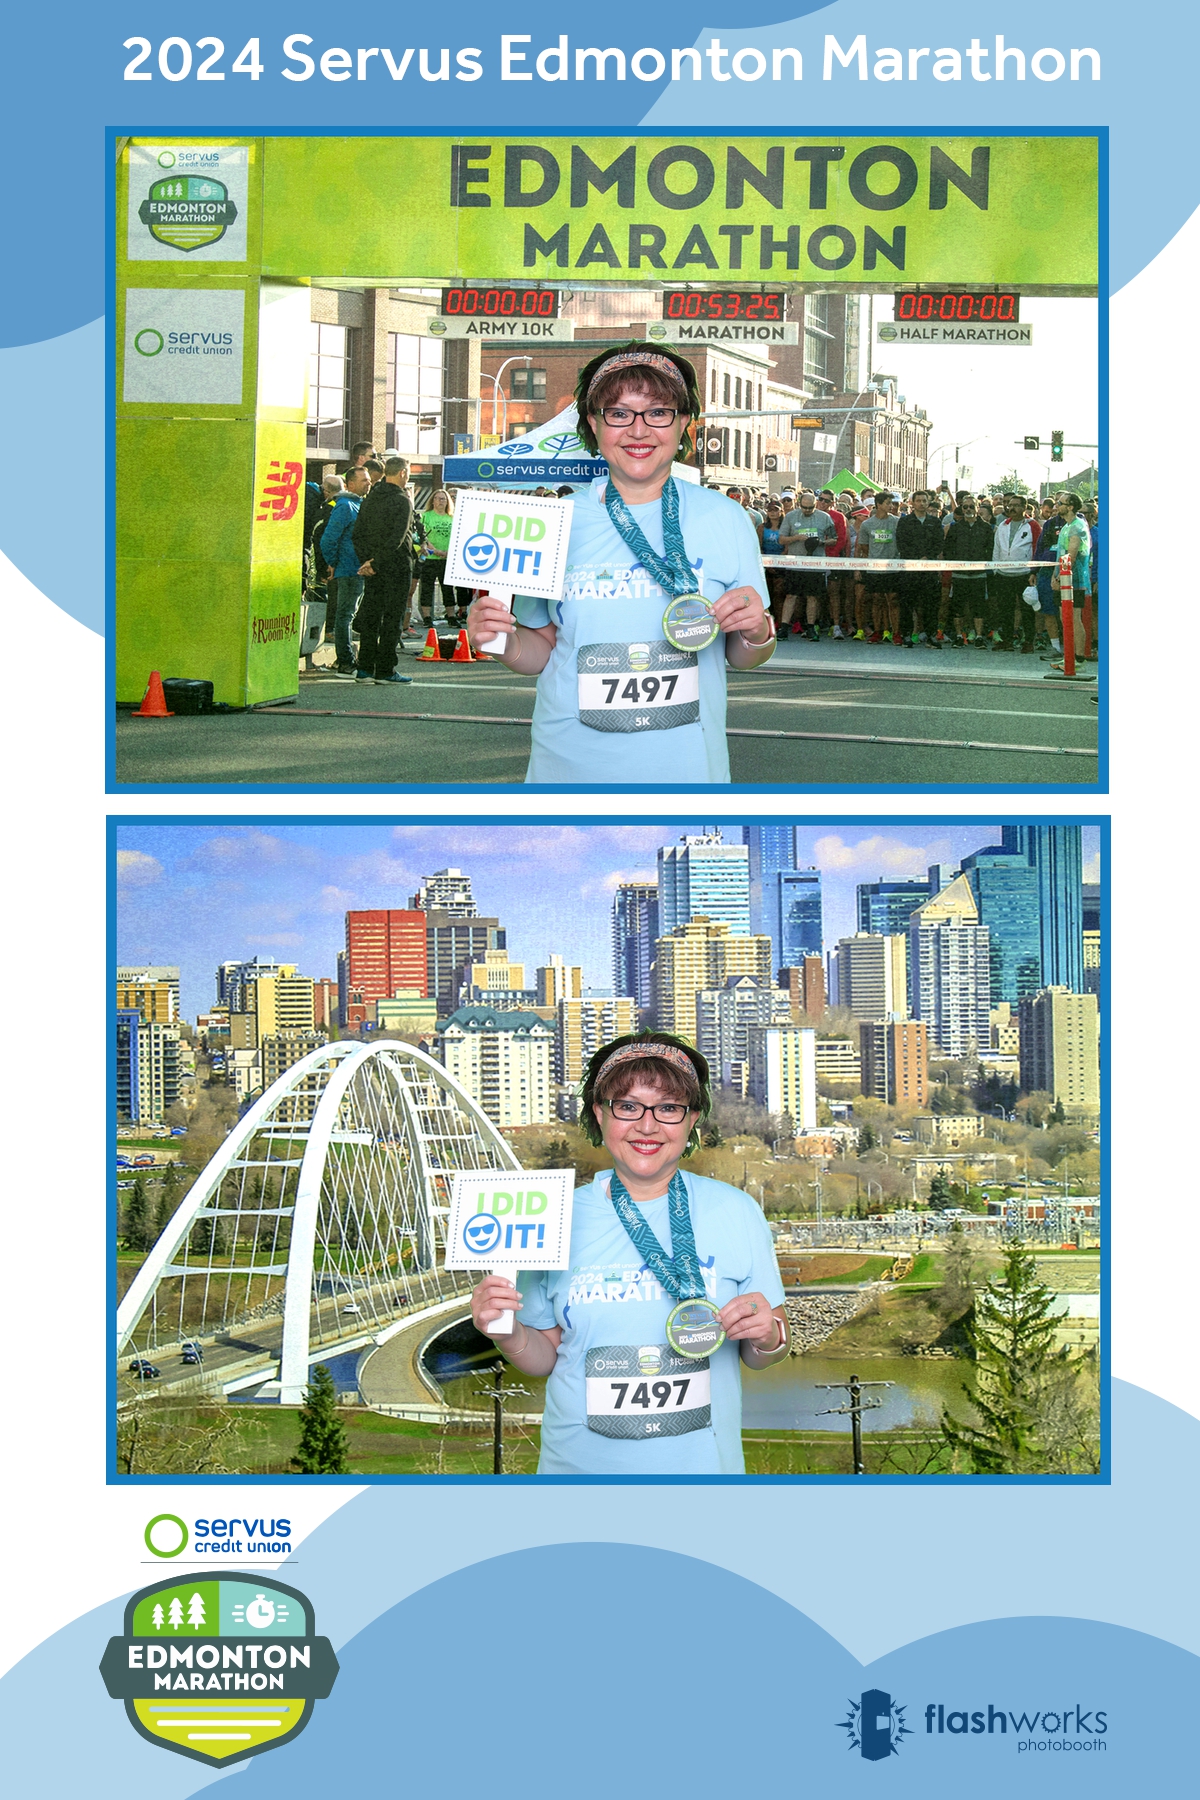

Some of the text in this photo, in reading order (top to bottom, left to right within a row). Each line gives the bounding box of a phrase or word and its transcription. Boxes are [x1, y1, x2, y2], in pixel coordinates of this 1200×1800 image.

[178, 152, 219, 161] servus
[450, 144, 990, 210] EDMONTON
[149, 203, 226, 214] EDMONTON
[160, 214, 215, 222] MARATHON
[523, 223, 906, 271] MARATHON
[466, 321, 554, 336] ARMY 10K
[678, 325, 785, 340] MARATHON
[900, 328, 1031, 341] HALF MARATHON
[168, 331, 233, 345] servus
[167, 345, 233, 355] credit union
[496, 464, 545, 476] servus
[548, 463, 590, 476] credit
[476, 512, 486, 535] I
[491, 514, 547, 543] DID
[501, 547, 542, 576] IT!
[565, 570, 596, 583] 2024
[601, 674, 679, 704] 7497
[635, 716, 651, 727] 5K
[476, 1191, 548, 1216] I DID
[504, 1223, 546, 1249] IT!
[569, 1272, 604, 1287] 2024
[567, 1277, 717, 1307] MARATHN
[678, 1333, 717, 1345] MARATHON
[610, 1379, 691, 1409] 7497
[645, 1422, 661, 1433] 5K
